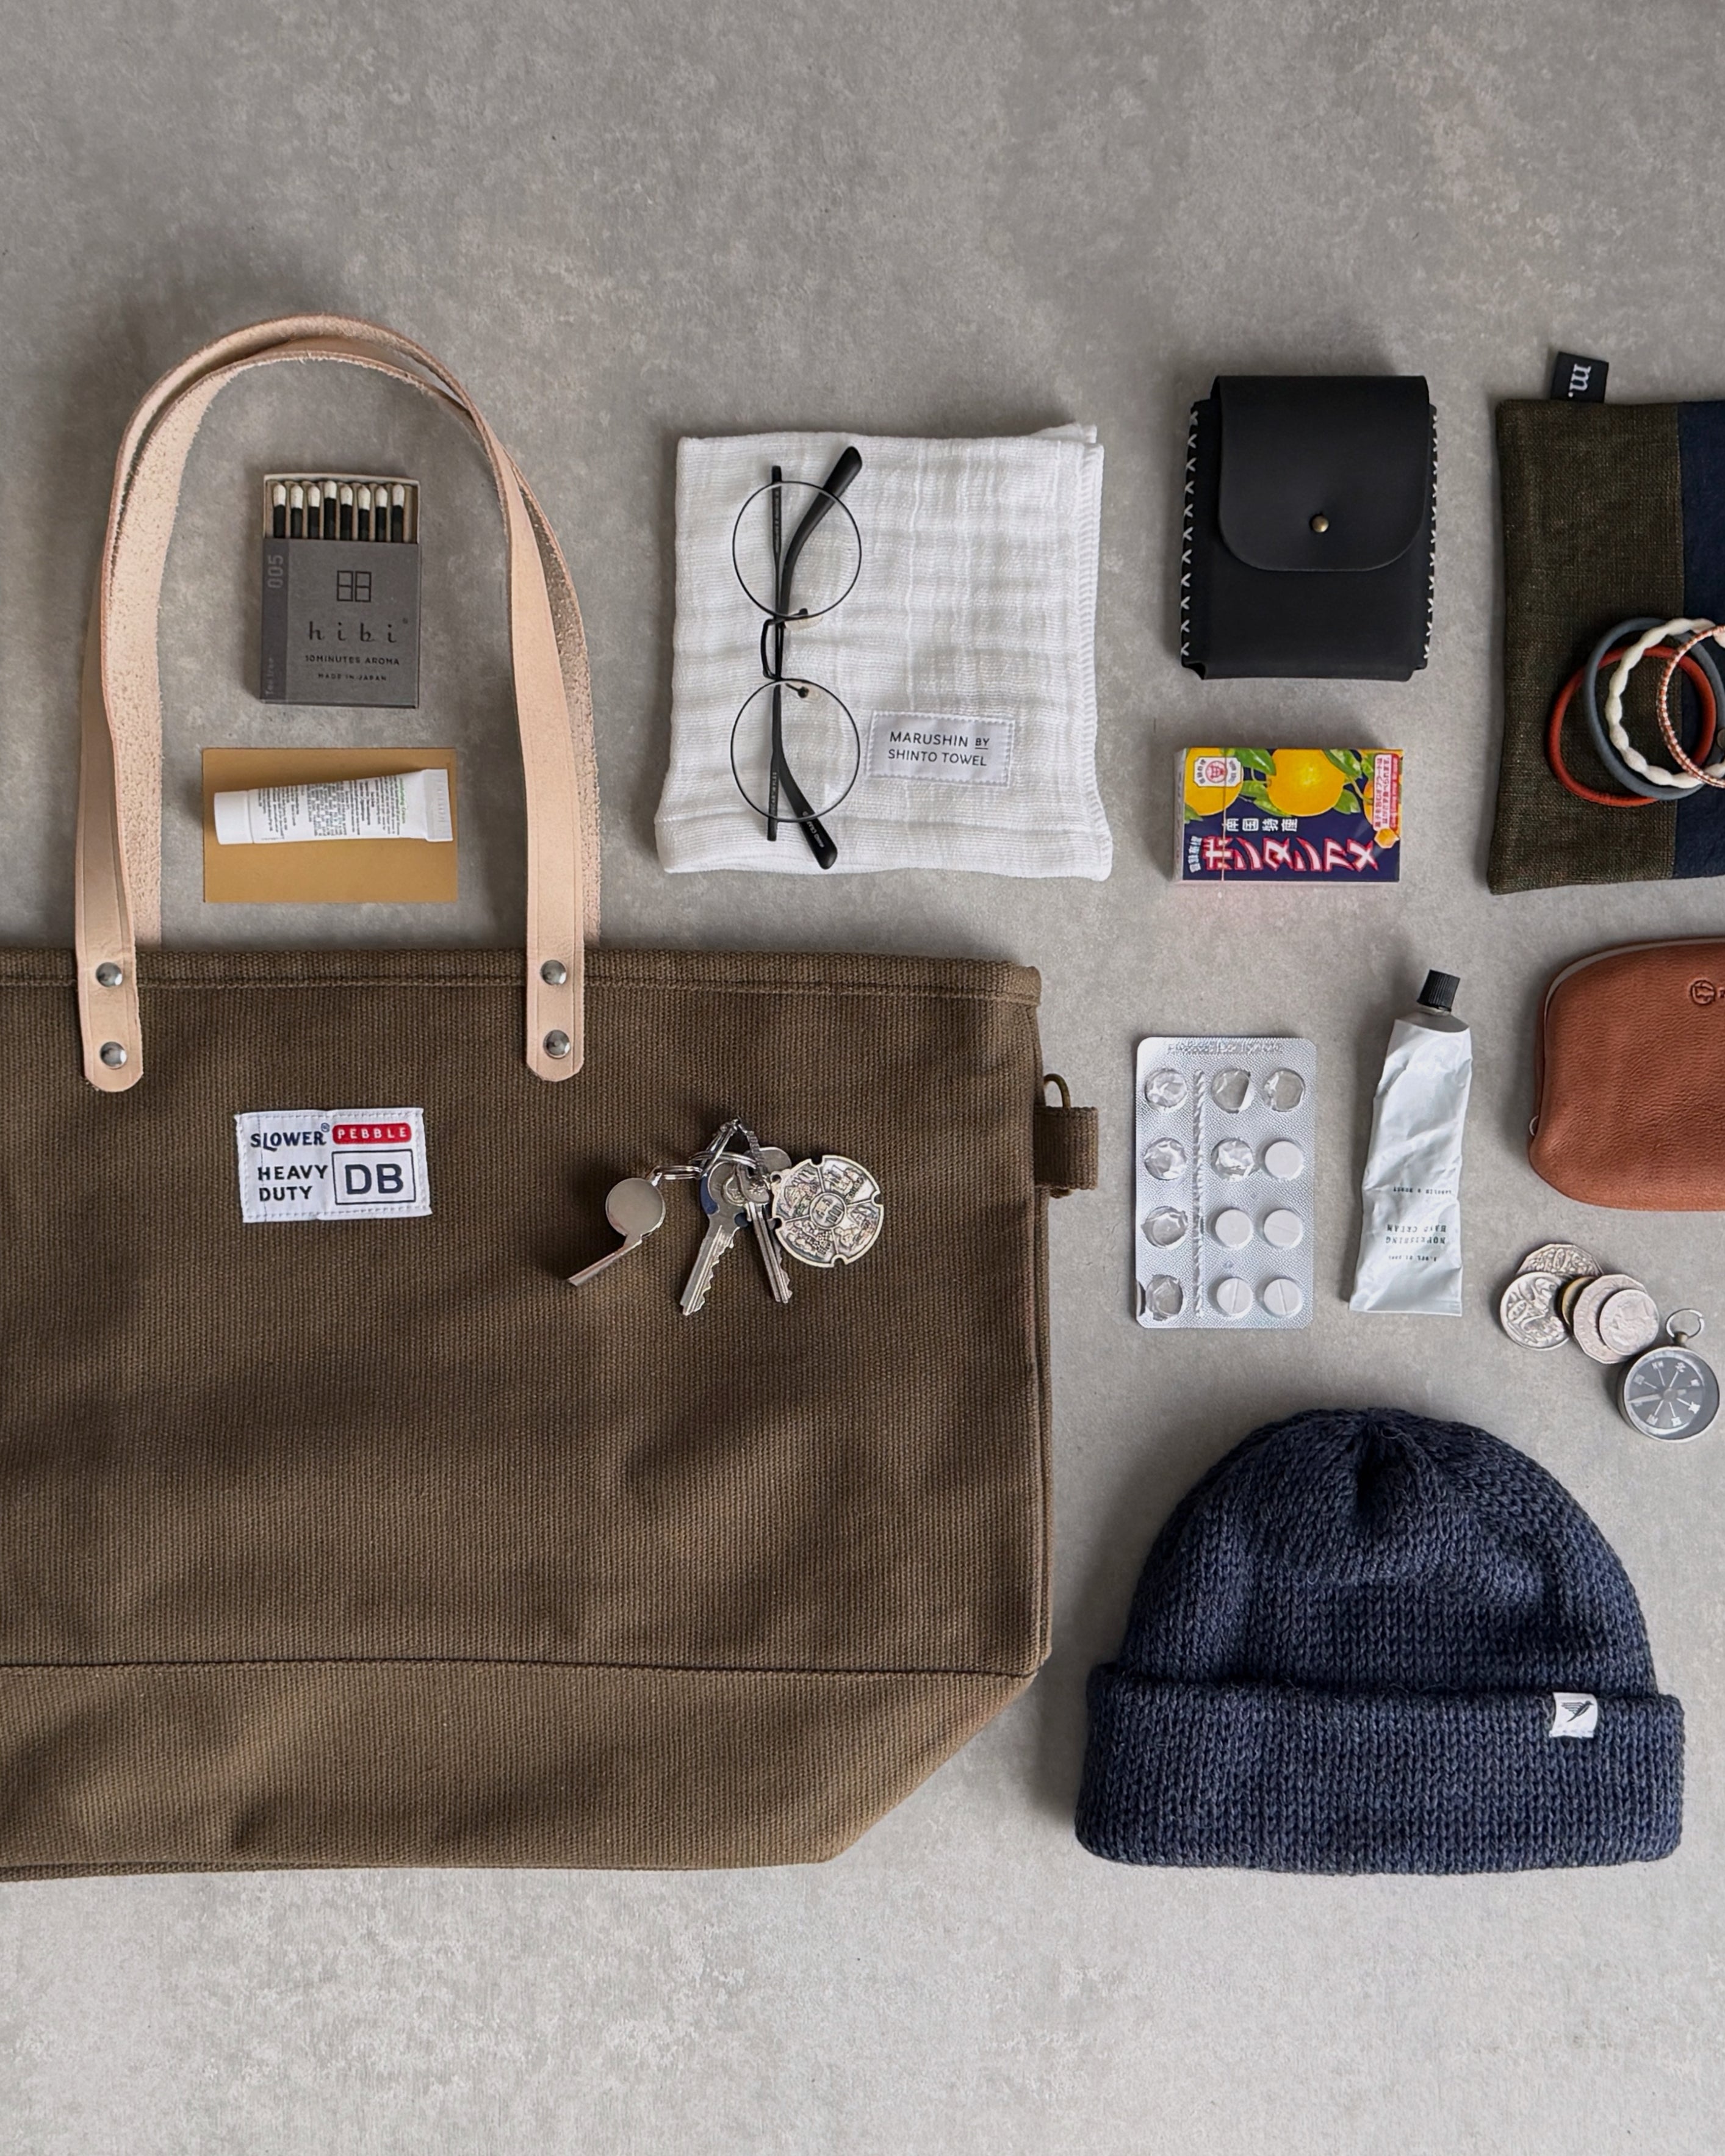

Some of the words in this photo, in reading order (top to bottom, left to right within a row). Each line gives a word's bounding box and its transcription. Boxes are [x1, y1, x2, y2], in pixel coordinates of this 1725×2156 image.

[268, 555, 284, 589] 005
[308, 621, 397, 643] hibi
[305, 655, 360, 663] 10MINUTES
[890, 731, 968, 747] MARUSHIN
[975, 737, 990, 747] BY
[888, 749, 937, 762] SHINTO
[942, 752, 987, 766] TOWEL
[1222, 818, 1298, 832] 南国特産
[1201, 835, 1379, 873] ボンタンアメ
[250, 1130, 326, 1152] SLOWER
[337, 1127, 407, 1139] PEBBLE
[257, 1165, 328, 1181] HEAVY
[345, 1163, 403, 1194] DB
[259, 1185, 312, 1202] DUTY
